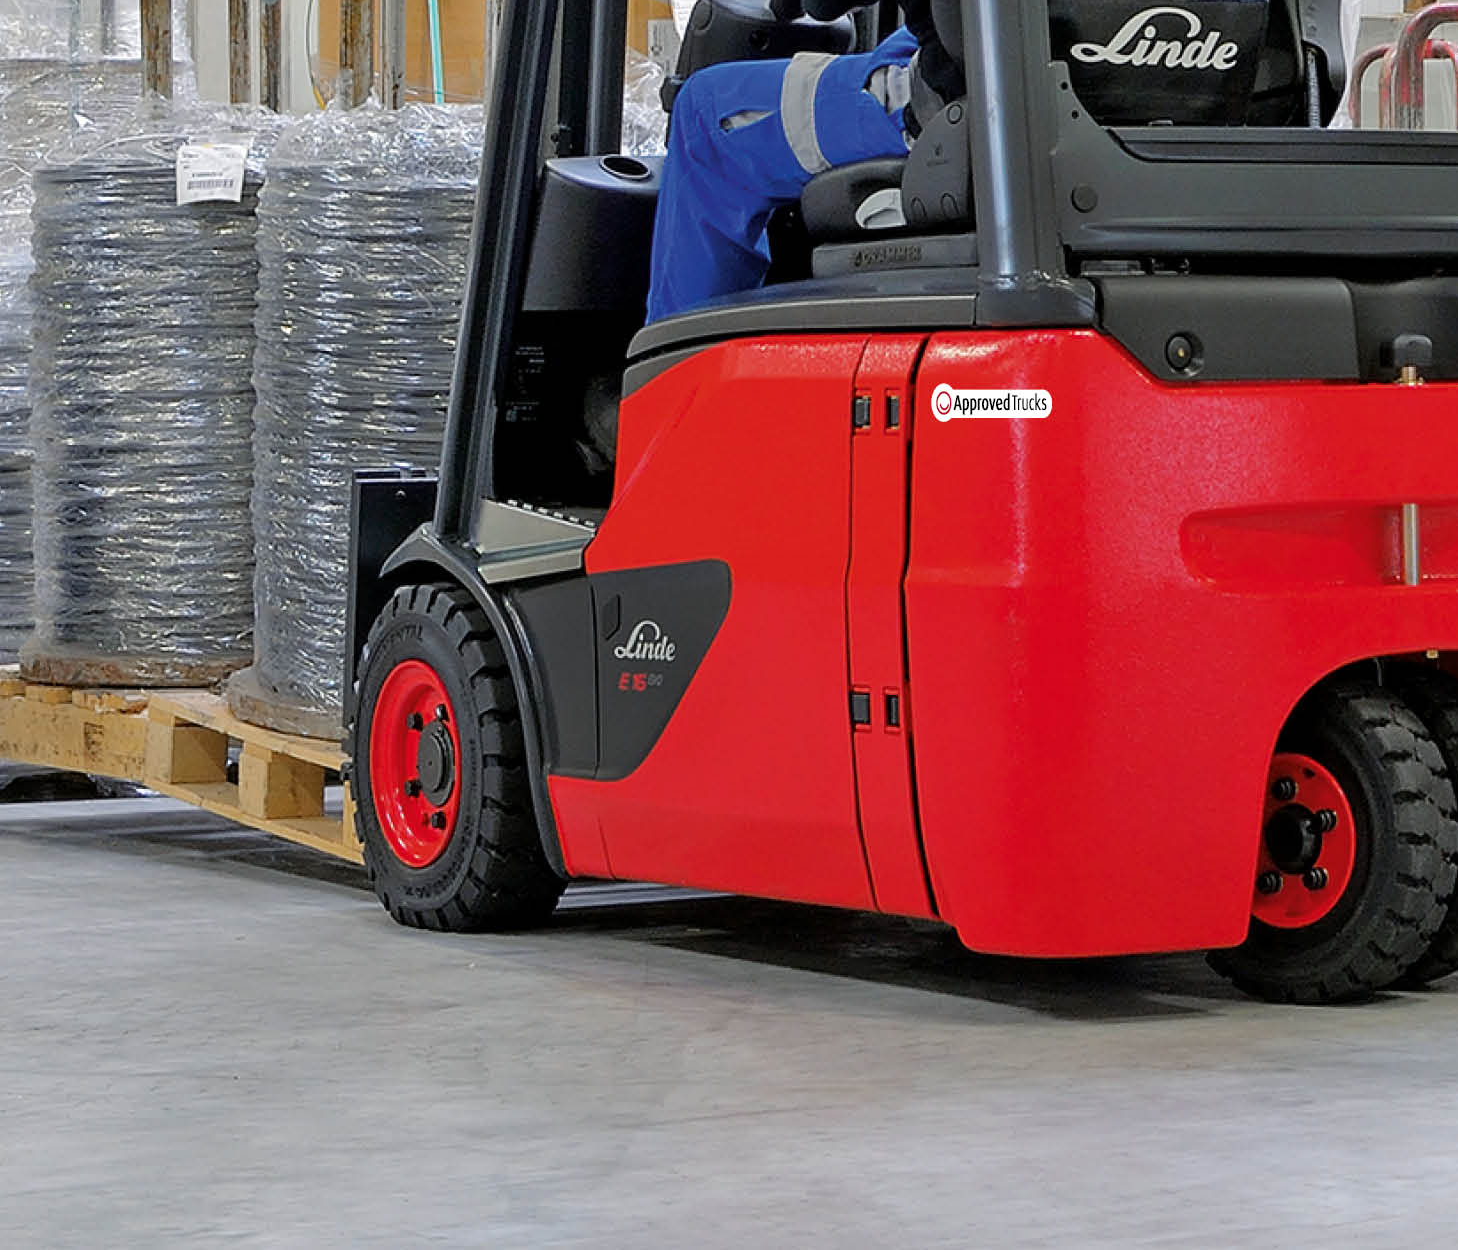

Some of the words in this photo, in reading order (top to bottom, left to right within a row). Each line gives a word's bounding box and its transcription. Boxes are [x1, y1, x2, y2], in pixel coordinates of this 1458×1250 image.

[1070, 6, 1238, 70] Linde
[953, 393, 1010, 415] Approved
[1011, 393, 1047, 411] Trucks
[613, 620, 676, 661] Linde
